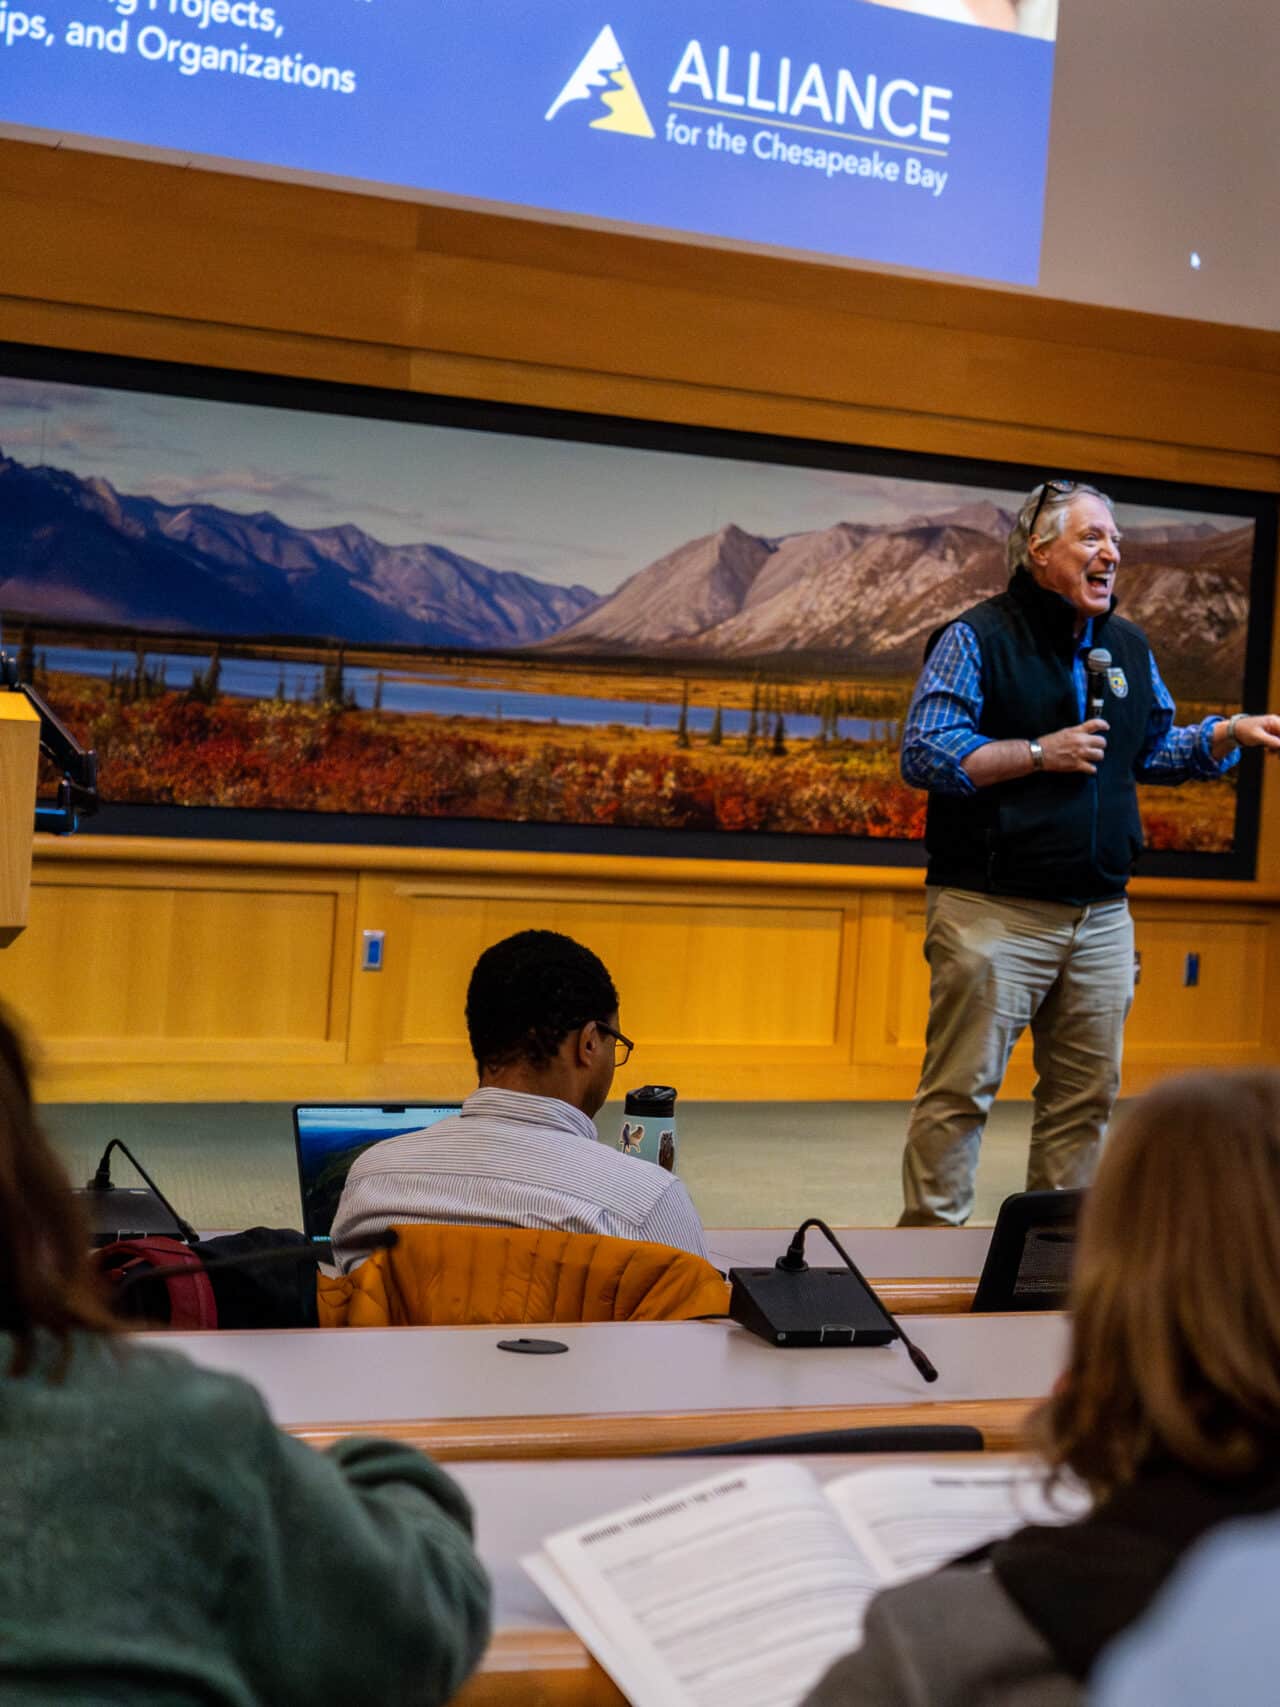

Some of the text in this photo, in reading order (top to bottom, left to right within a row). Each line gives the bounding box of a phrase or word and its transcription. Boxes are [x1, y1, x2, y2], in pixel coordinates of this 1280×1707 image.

[65, 19, 129, 54] and
[137, 25, 356, 94] Organizations
[668, 39, 953, 145] ALLIANCE
[665, 113, 949, 198] for the Chesapeake Bay
